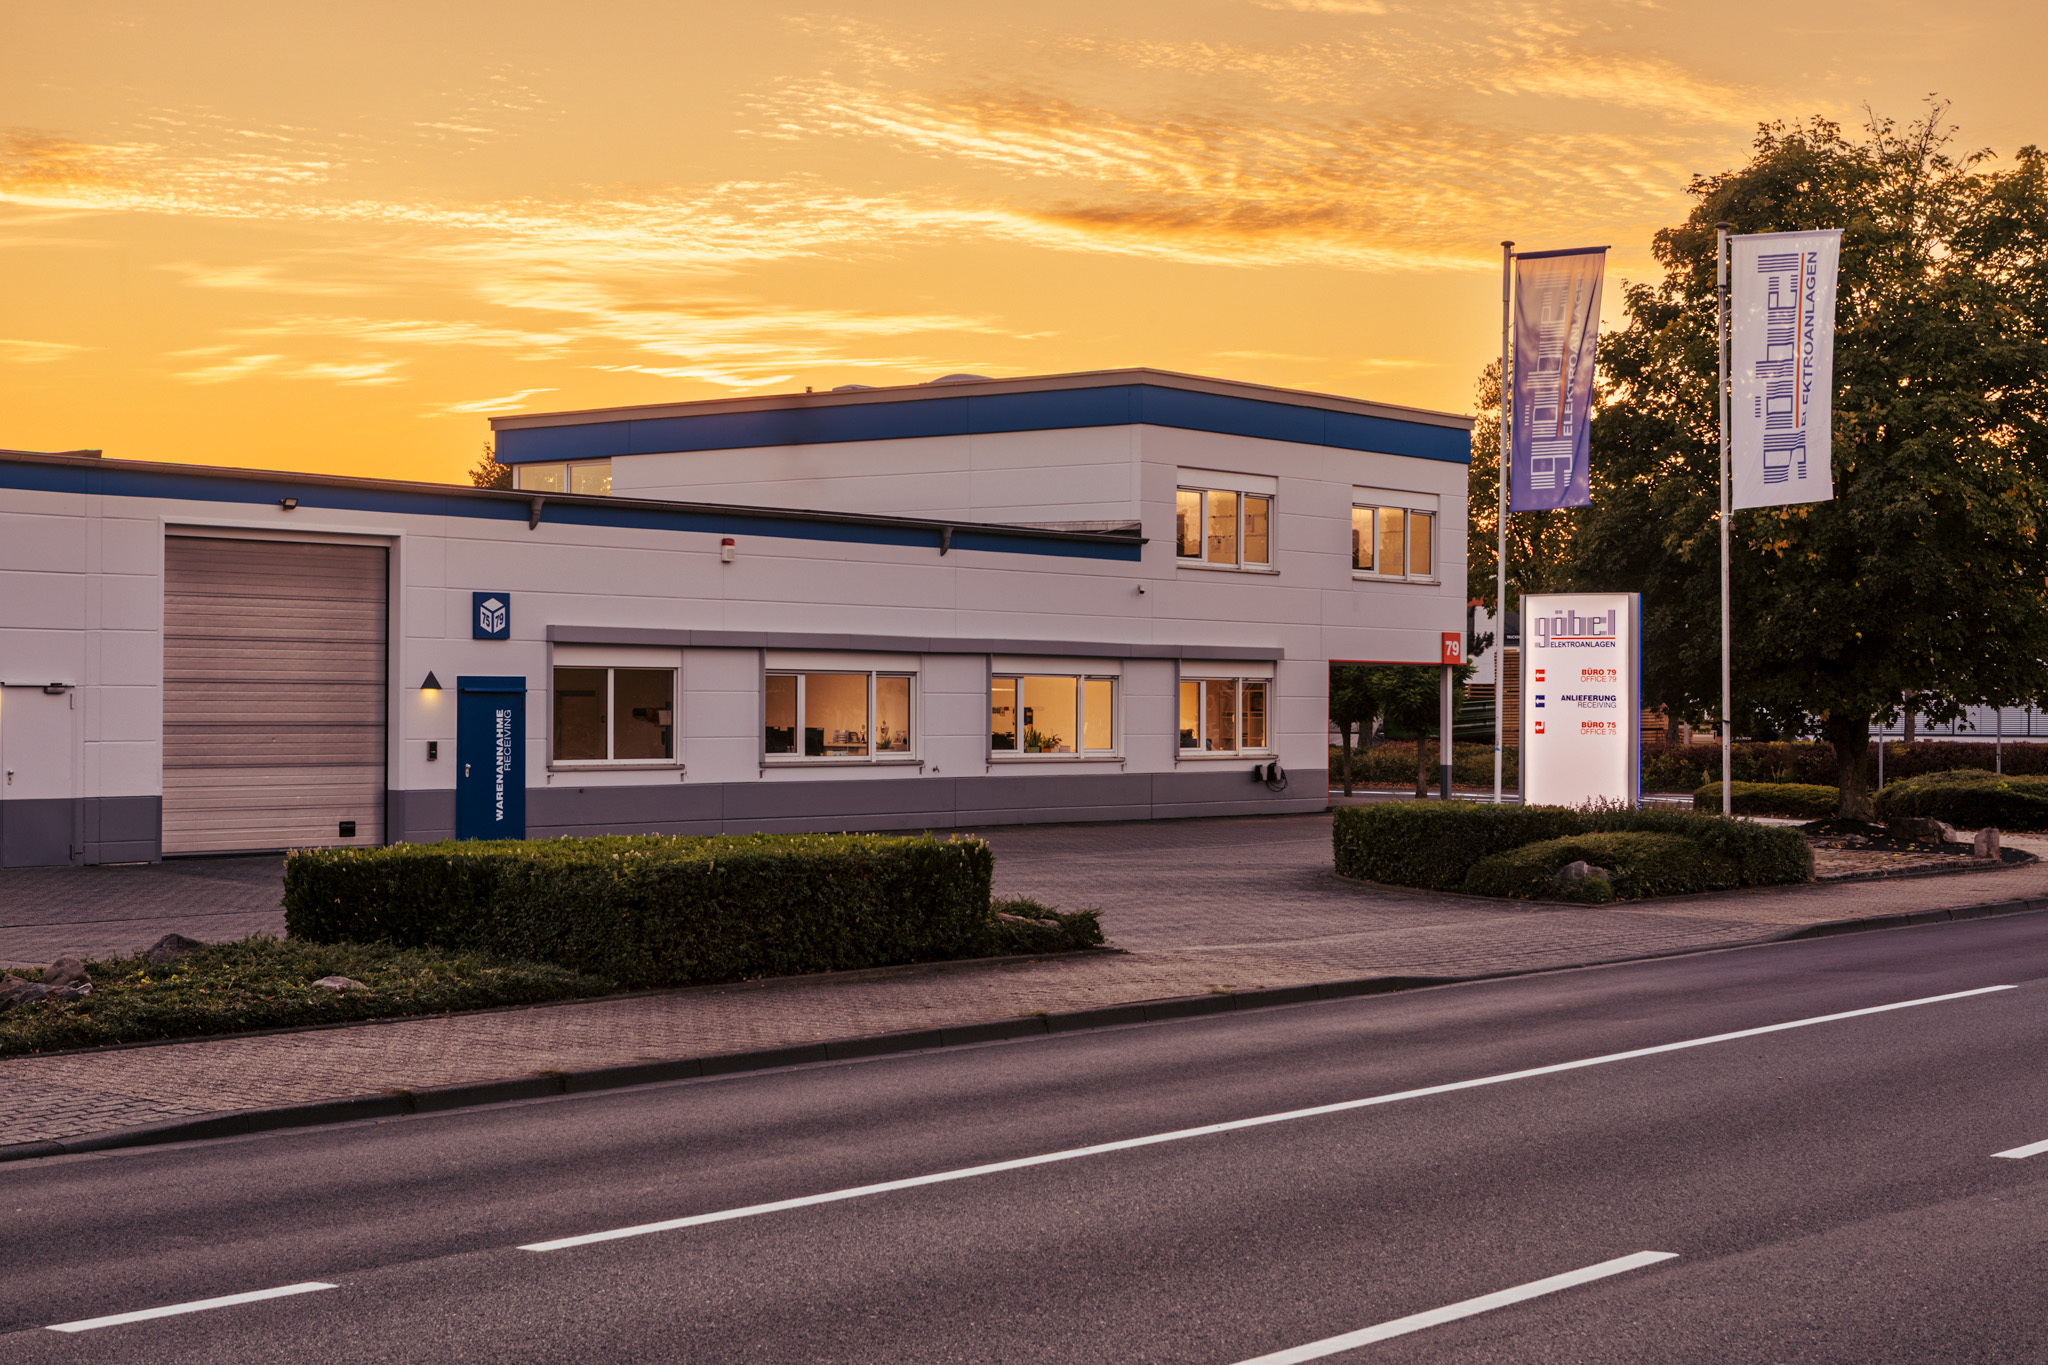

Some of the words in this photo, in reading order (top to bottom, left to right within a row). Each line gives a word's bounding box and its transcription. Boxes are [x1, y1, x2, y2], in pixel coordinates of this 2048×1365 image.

[1563, 268, 1584, 437] ELEKTROANLAGEN
[1755, 253, 1807, 484] göbel
[1524, 270, 1573, 490] göbel
[482, 611, 491, 628] 75
[495, 612, 504, 628] 79
[1534, 609, 1616, 648] göbel
[1445, 640, 1460, 656] 79
[1550, 640, 1616, 648] ELEKTROANLAGEN
[1580, 675, 1607, 683] OFFICE
[1608, 675, 1617, 683] 79
[1581, 667, 1605, 676] BÜRO
[1606, 668, 1617, 676] 79
[1561, 694, 1617, 702] ANLIEFERUNG
[1577, 701, 1617, 709] RECEIVING
[1580, 728, 1607, 736] OFFICE
[1608, 728, 1617, 736] 75
[1581, 719, 1605, 728] BÜRO
[1606, 721, 1617, 729] 75
[503, 709, 512, 771] RECEIVING
[495, 709, 504, 822] WARENANNAHME
